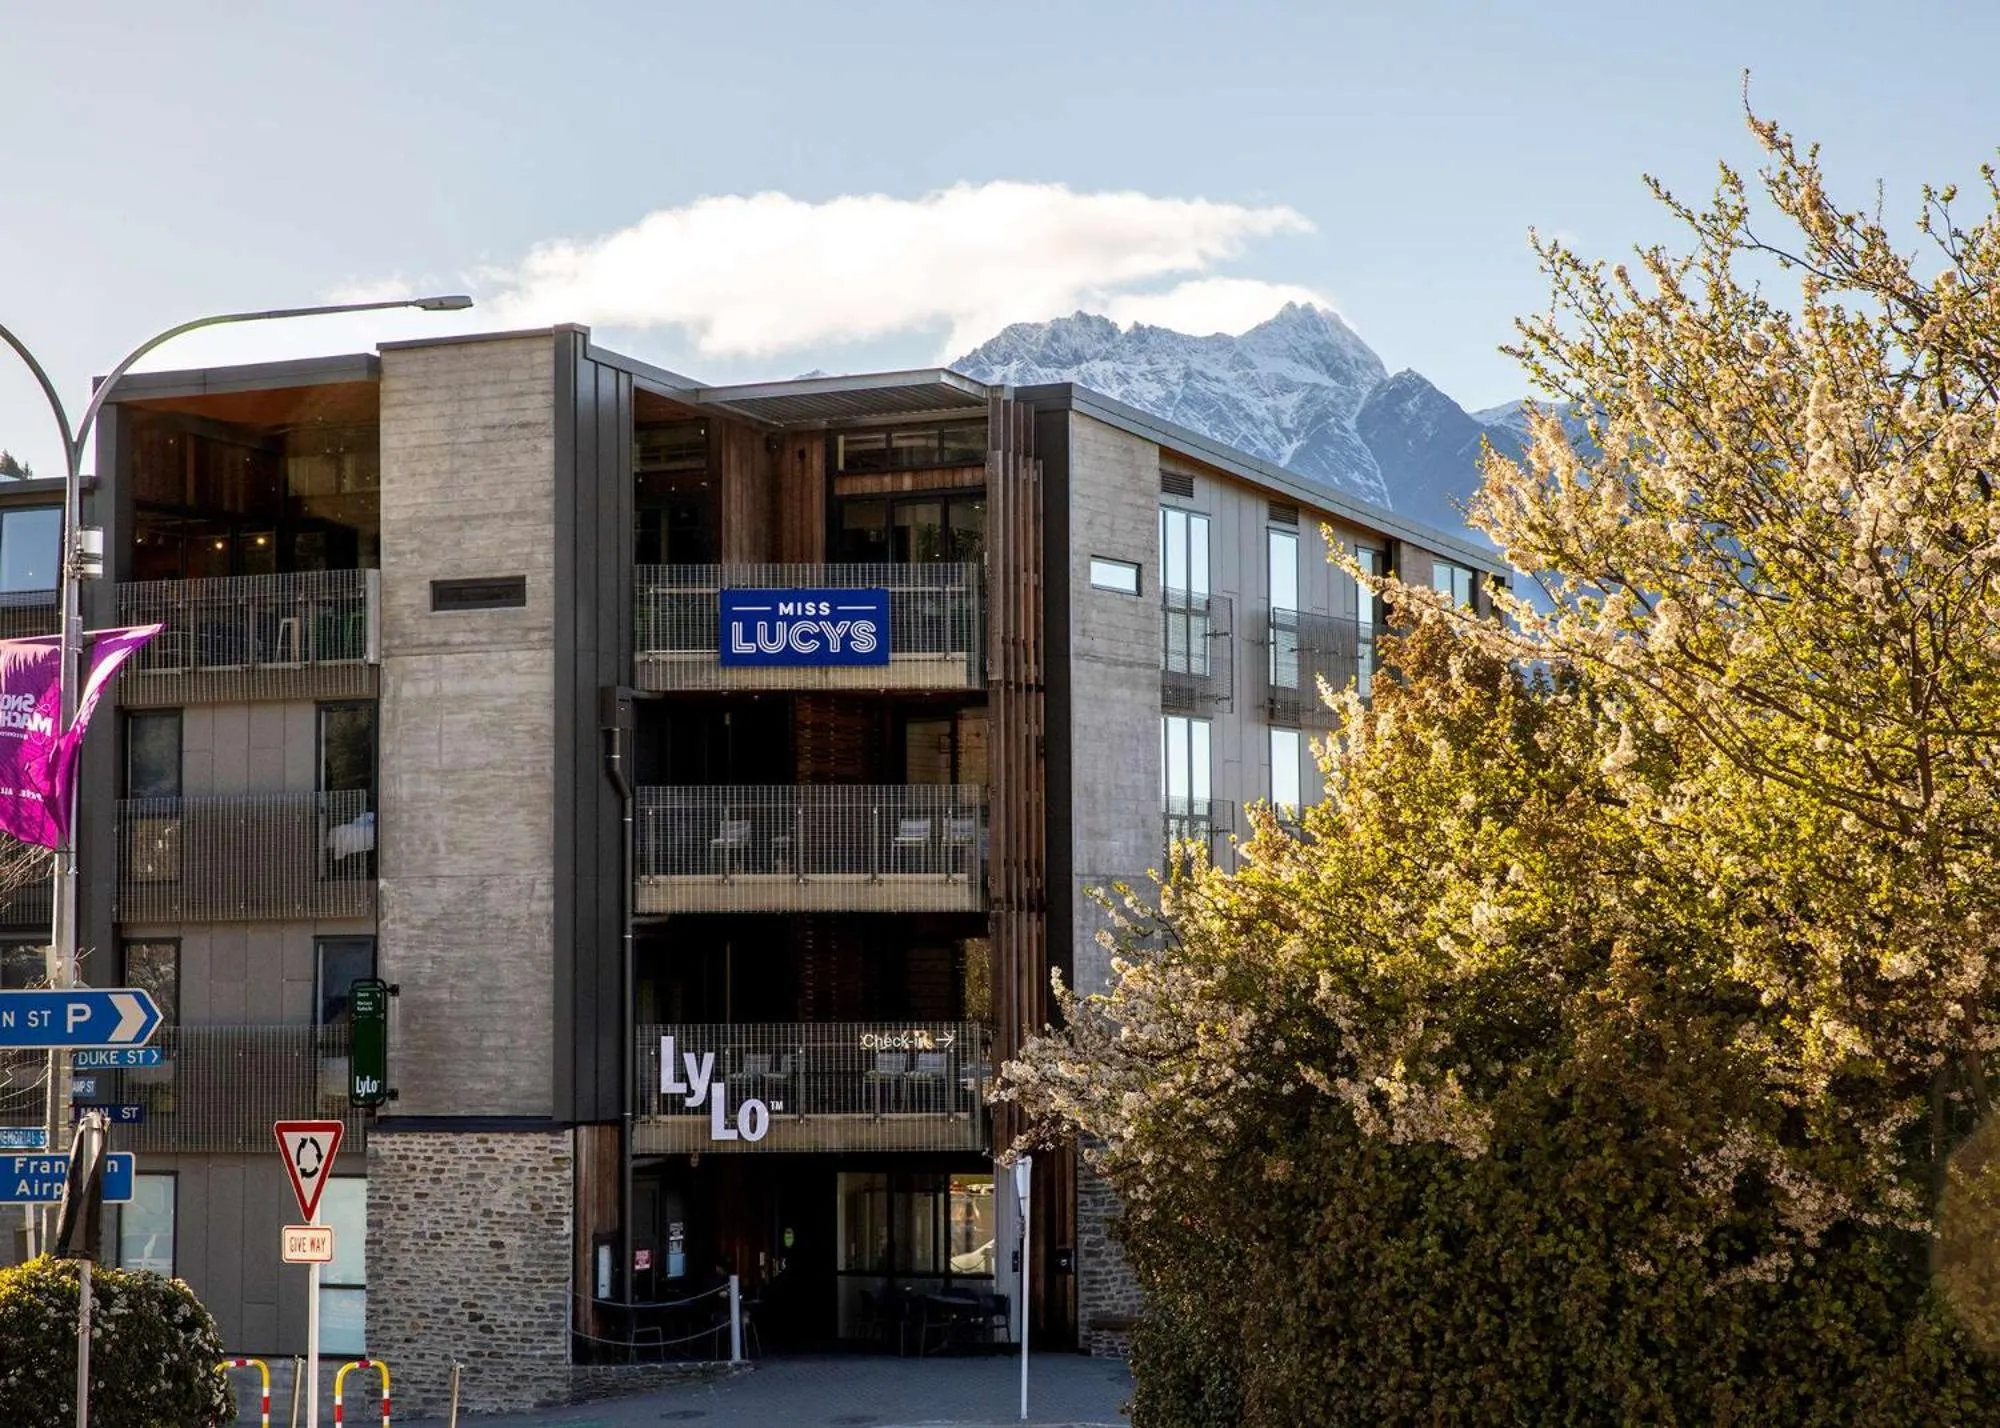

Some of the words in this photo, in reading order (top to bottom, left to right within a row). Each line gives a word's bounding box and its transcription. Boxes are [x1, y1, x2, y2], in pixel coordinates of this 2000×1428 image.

[778, 602, 830, 616] MISS
[732, 620, 877, 653] LUCYS
[2, 1010, 15, 1028] N
[27, 1010, 51, 1028] ST
[66, 1003, 92, 1034] P
[78, 1051, 119, 1065] DUKE
[127, 1050, 146, 1064] ST
[72, 1080, 85, 1092] AMP
[121, 1107, 139, 1119] ST
[39, 1130, 45, 1145] S
[14, 1157, 118, 1174] Frann
[15, 1179, 65, 1199] Airp
[290, 1237, 307, 1252] GIVE
[310, 1237, 326, 1252] WAY
